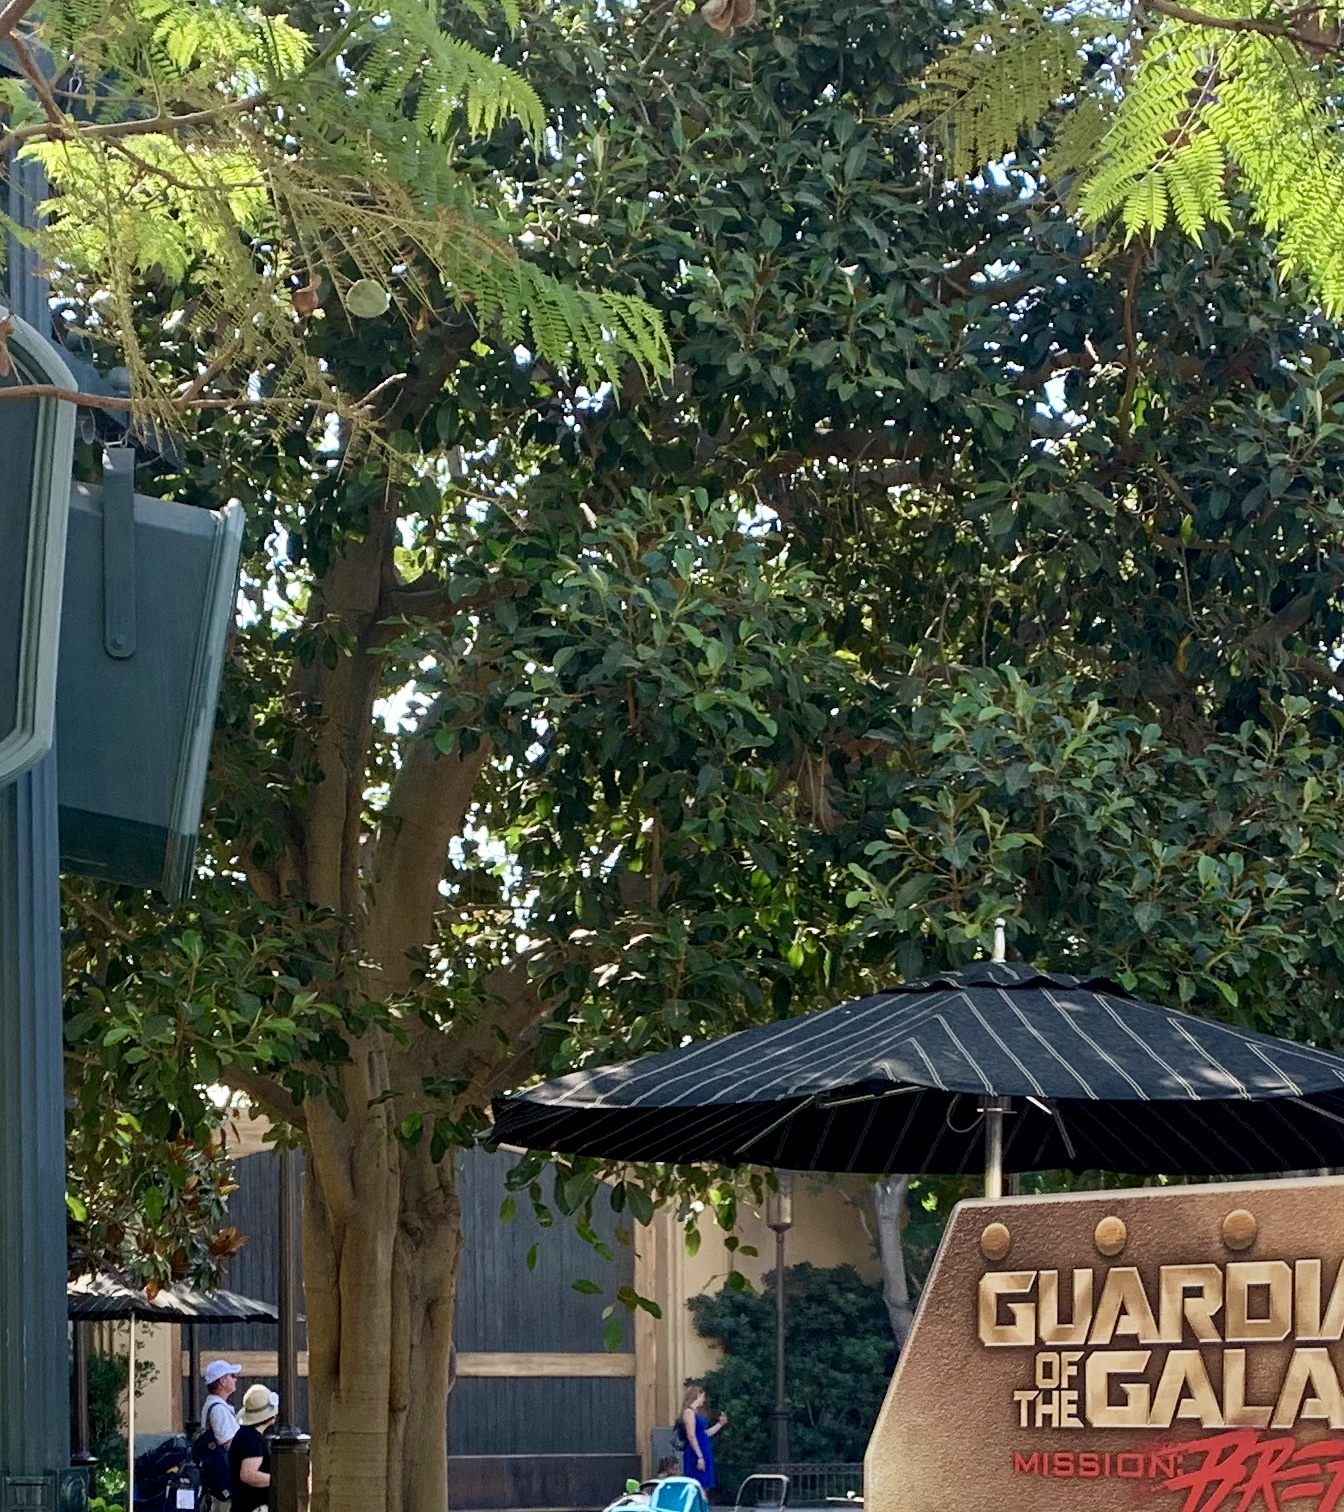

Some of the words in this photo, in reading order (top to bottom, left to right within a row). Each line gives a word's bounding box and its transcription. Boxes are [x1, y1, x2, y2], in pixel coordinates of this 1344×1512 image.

[1034, 1352, 1085, 1389] OF
[1013, 1389, 1084, 1429] THE
[1014, 1452, 1184, 1479] MISSION:
